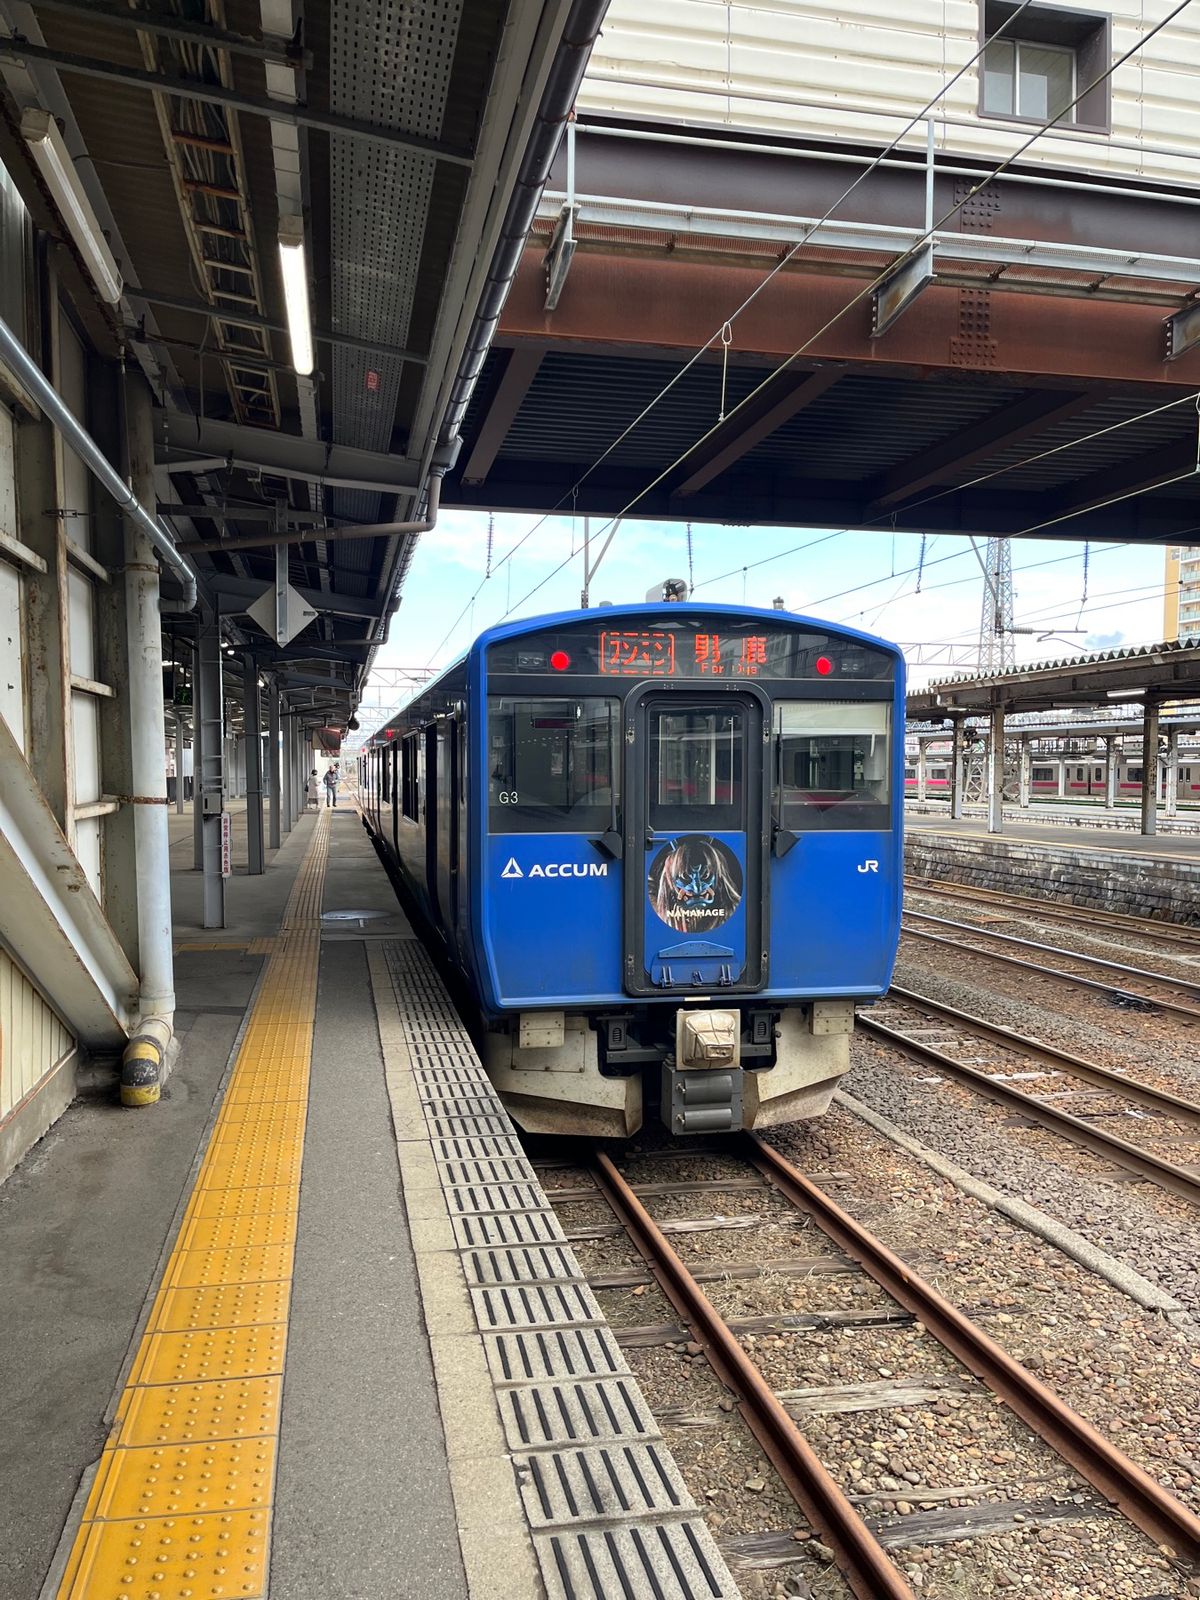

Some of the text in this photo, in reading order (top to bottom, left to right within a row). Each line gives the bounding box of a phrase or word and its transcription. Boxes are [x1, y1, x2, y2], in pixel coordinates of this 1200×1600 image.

[695, 634, 768, 664] 男鹿
[701, 662, 724, 674] For
[499, 791, 519, 804] G3
[528, 863, 608, 878] ACCUM
[857, 860, 879, 873] JR
[666, 908, 726, 918] NAMAHAGE
